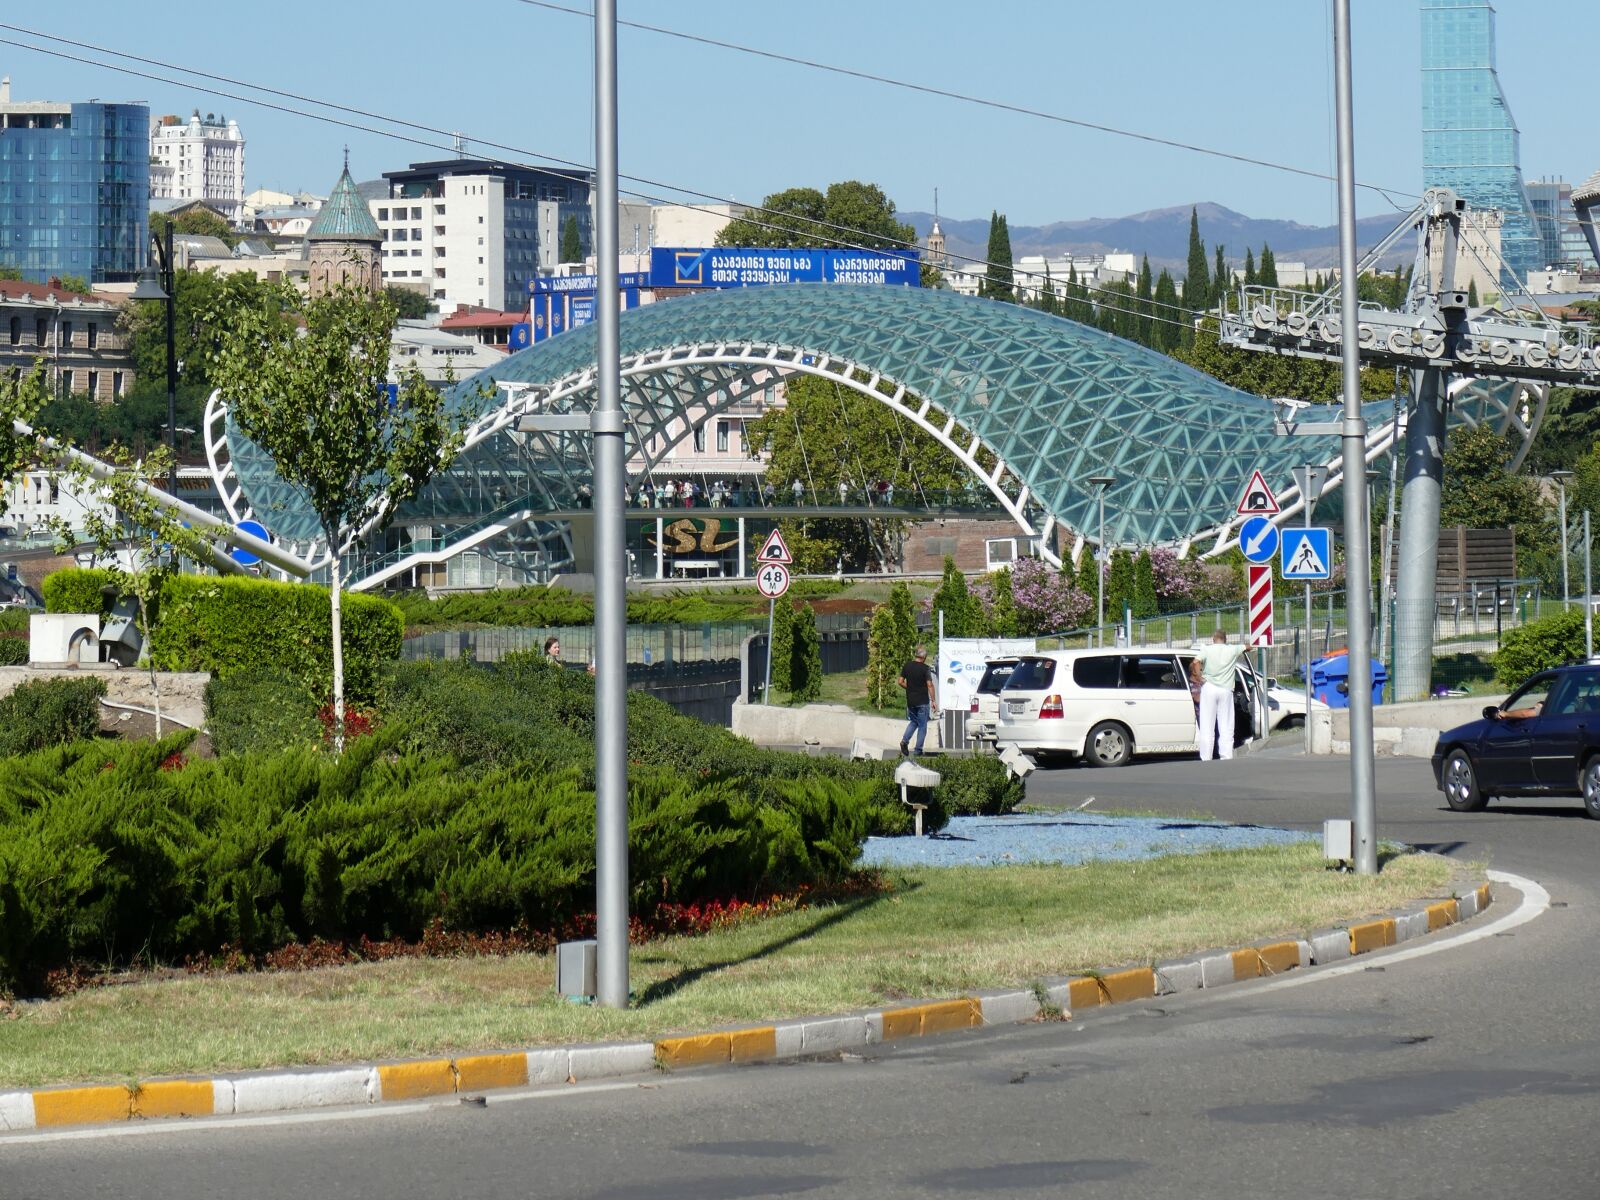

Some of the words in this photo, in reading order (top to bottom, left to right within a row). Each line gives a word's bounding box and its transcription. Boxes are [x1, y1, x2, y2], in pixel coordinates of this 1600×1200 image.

[712, 256, 765, 269] გააგებინე
[767, 257, 791, 270] შენი
[794, 257, 811, 270] ხმა
[833, 258, 906, 271] საპრეზიდენტო
[712, 269, 738, 282] მთელ
[834, 271, 885, 284] არჩევნები
